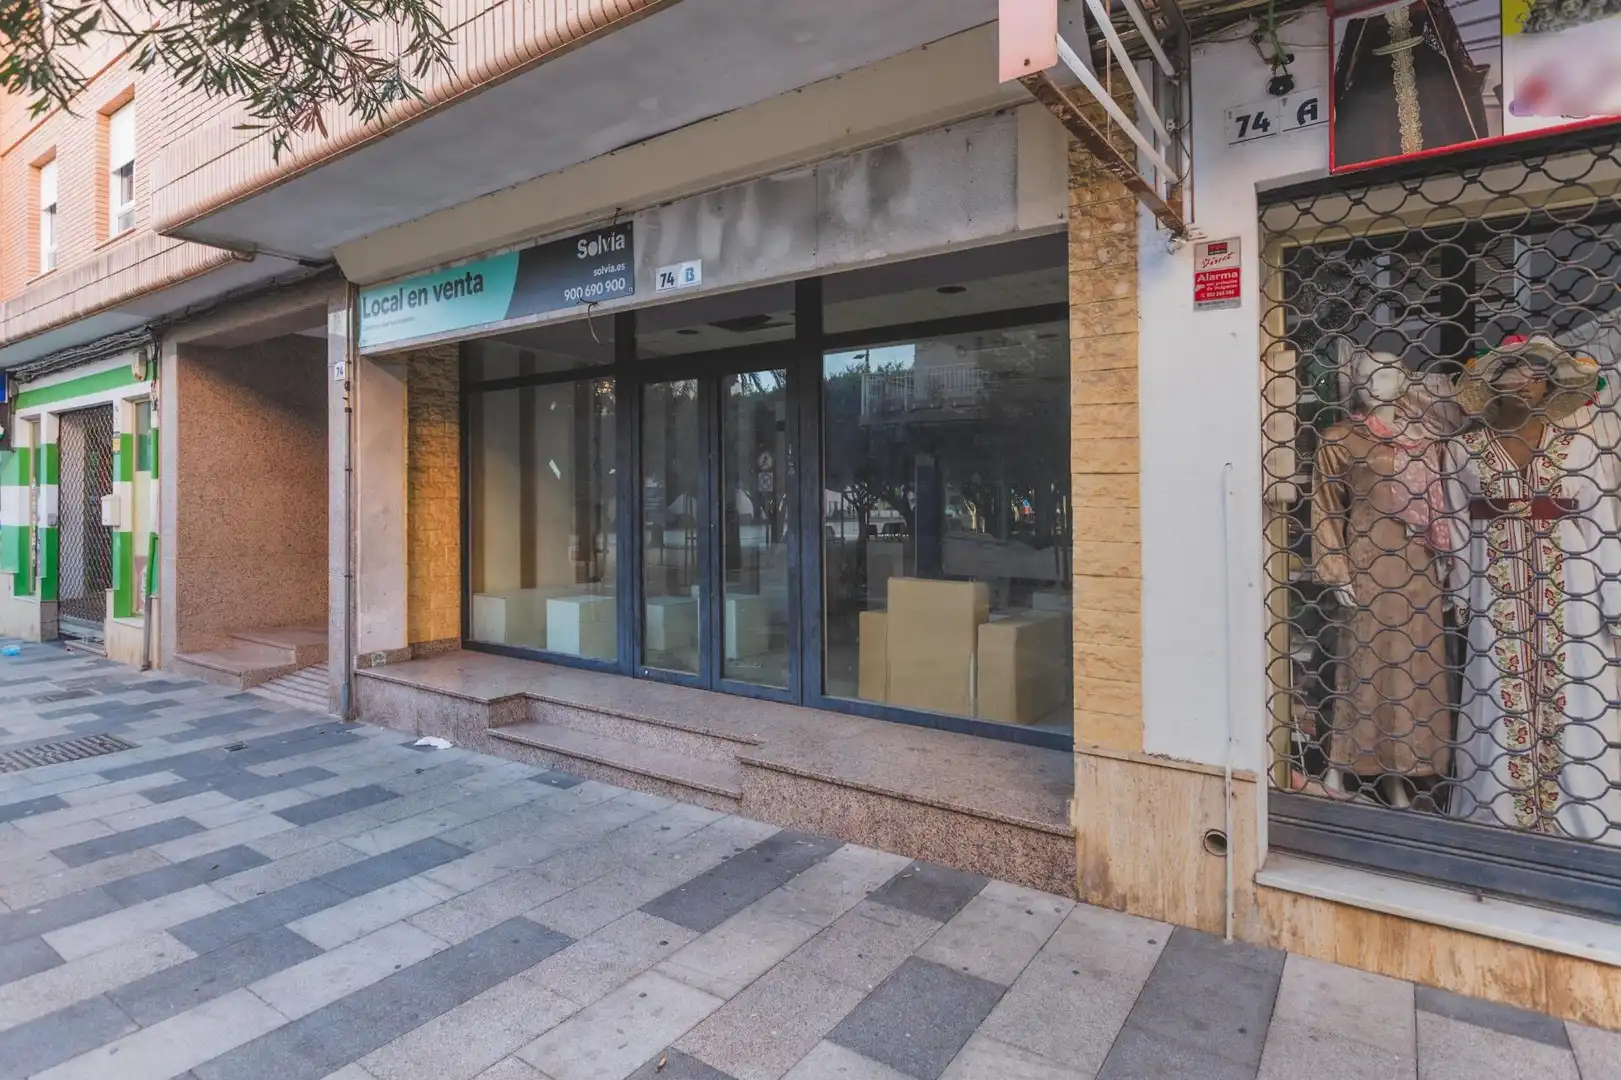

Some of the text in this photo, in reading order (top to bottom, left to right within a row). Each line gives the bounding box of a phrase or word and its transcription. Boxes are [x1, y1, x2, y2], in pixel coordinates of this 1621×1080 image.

[1235, 97, 1318, 138] 74 A
[577, 231, 625, 259] Solvia
[593, 262, 626, 277] solvia.es
[660, 266, 695, 288] 74 B
[1197, 271, 1239, 282] Alarma
[362, 271, 484, 319] Local en venta
[564, 277, 626, 301] 900 690 900
